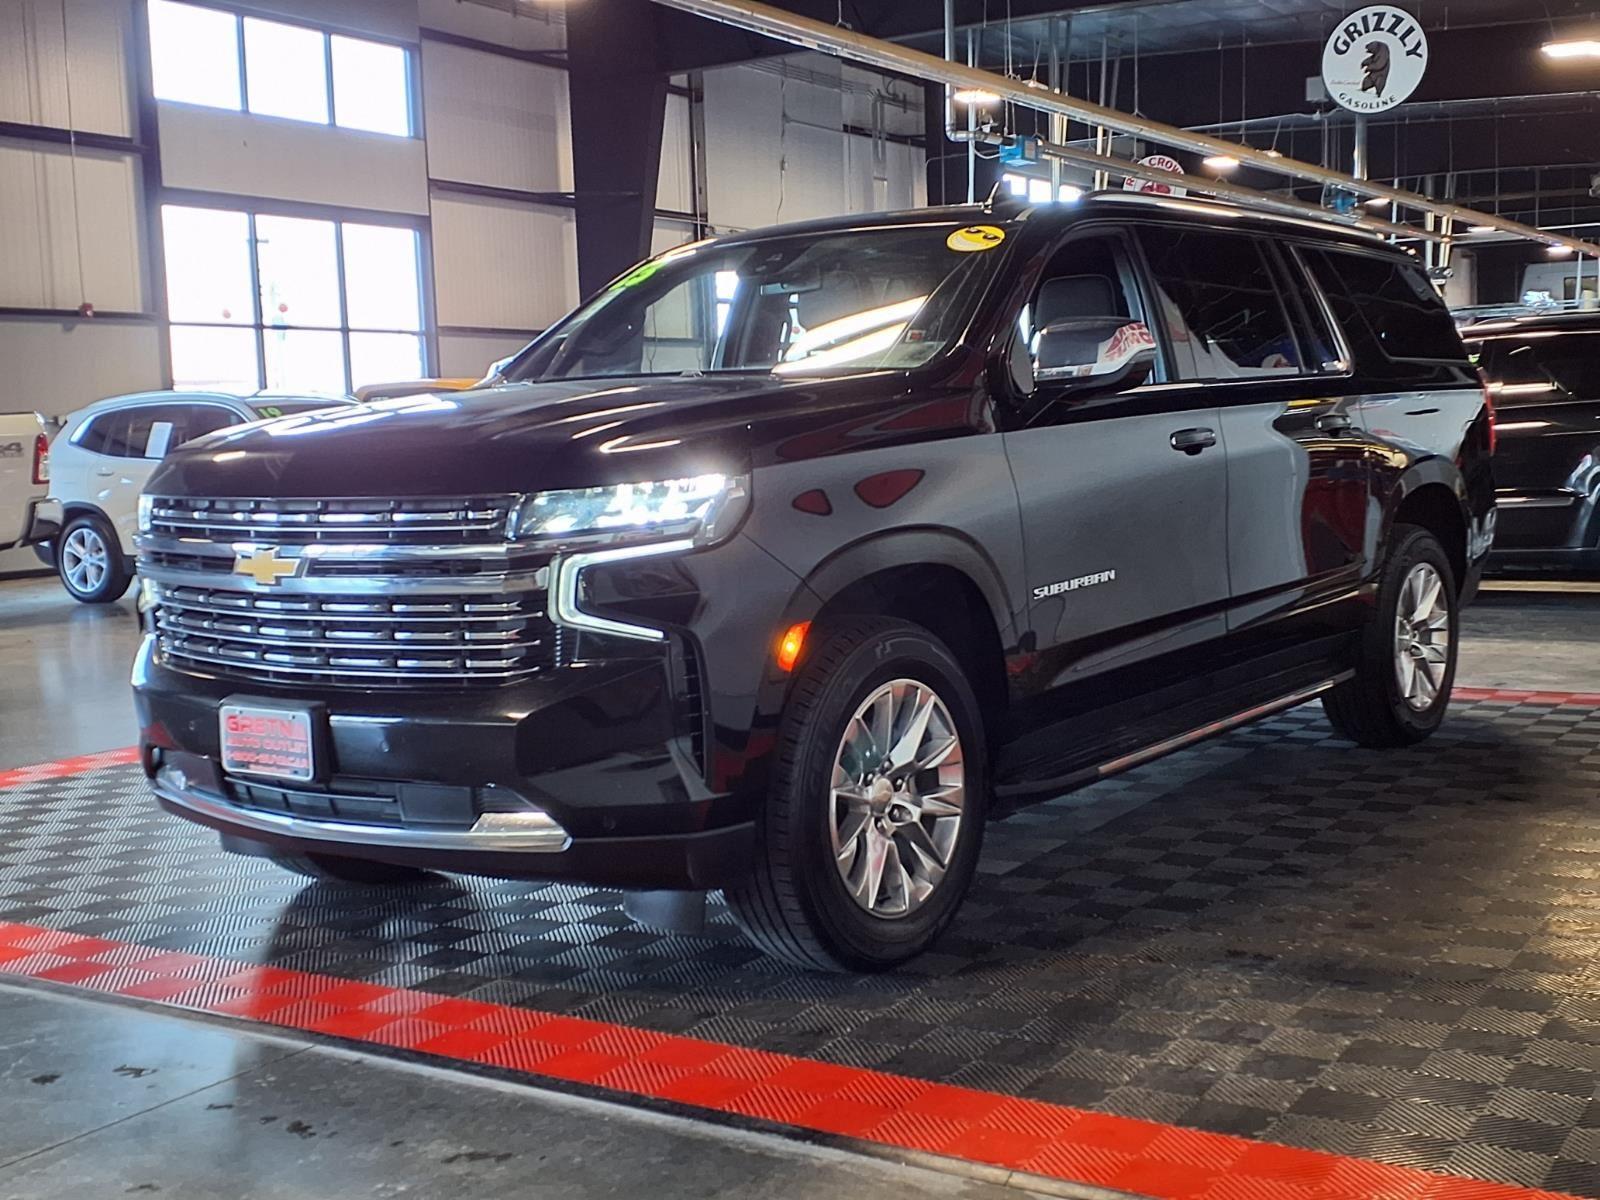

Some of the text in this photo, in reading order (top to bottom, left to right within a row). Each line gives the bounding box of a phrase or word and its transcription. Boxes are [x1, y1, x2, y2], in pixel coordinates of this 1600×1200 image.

[1333, 12, 1423, 59] GRIZZLY
[1339, 93, 1397, 110] GASOLINE
[1033, 569, 1116, 600] SUBURBAN
